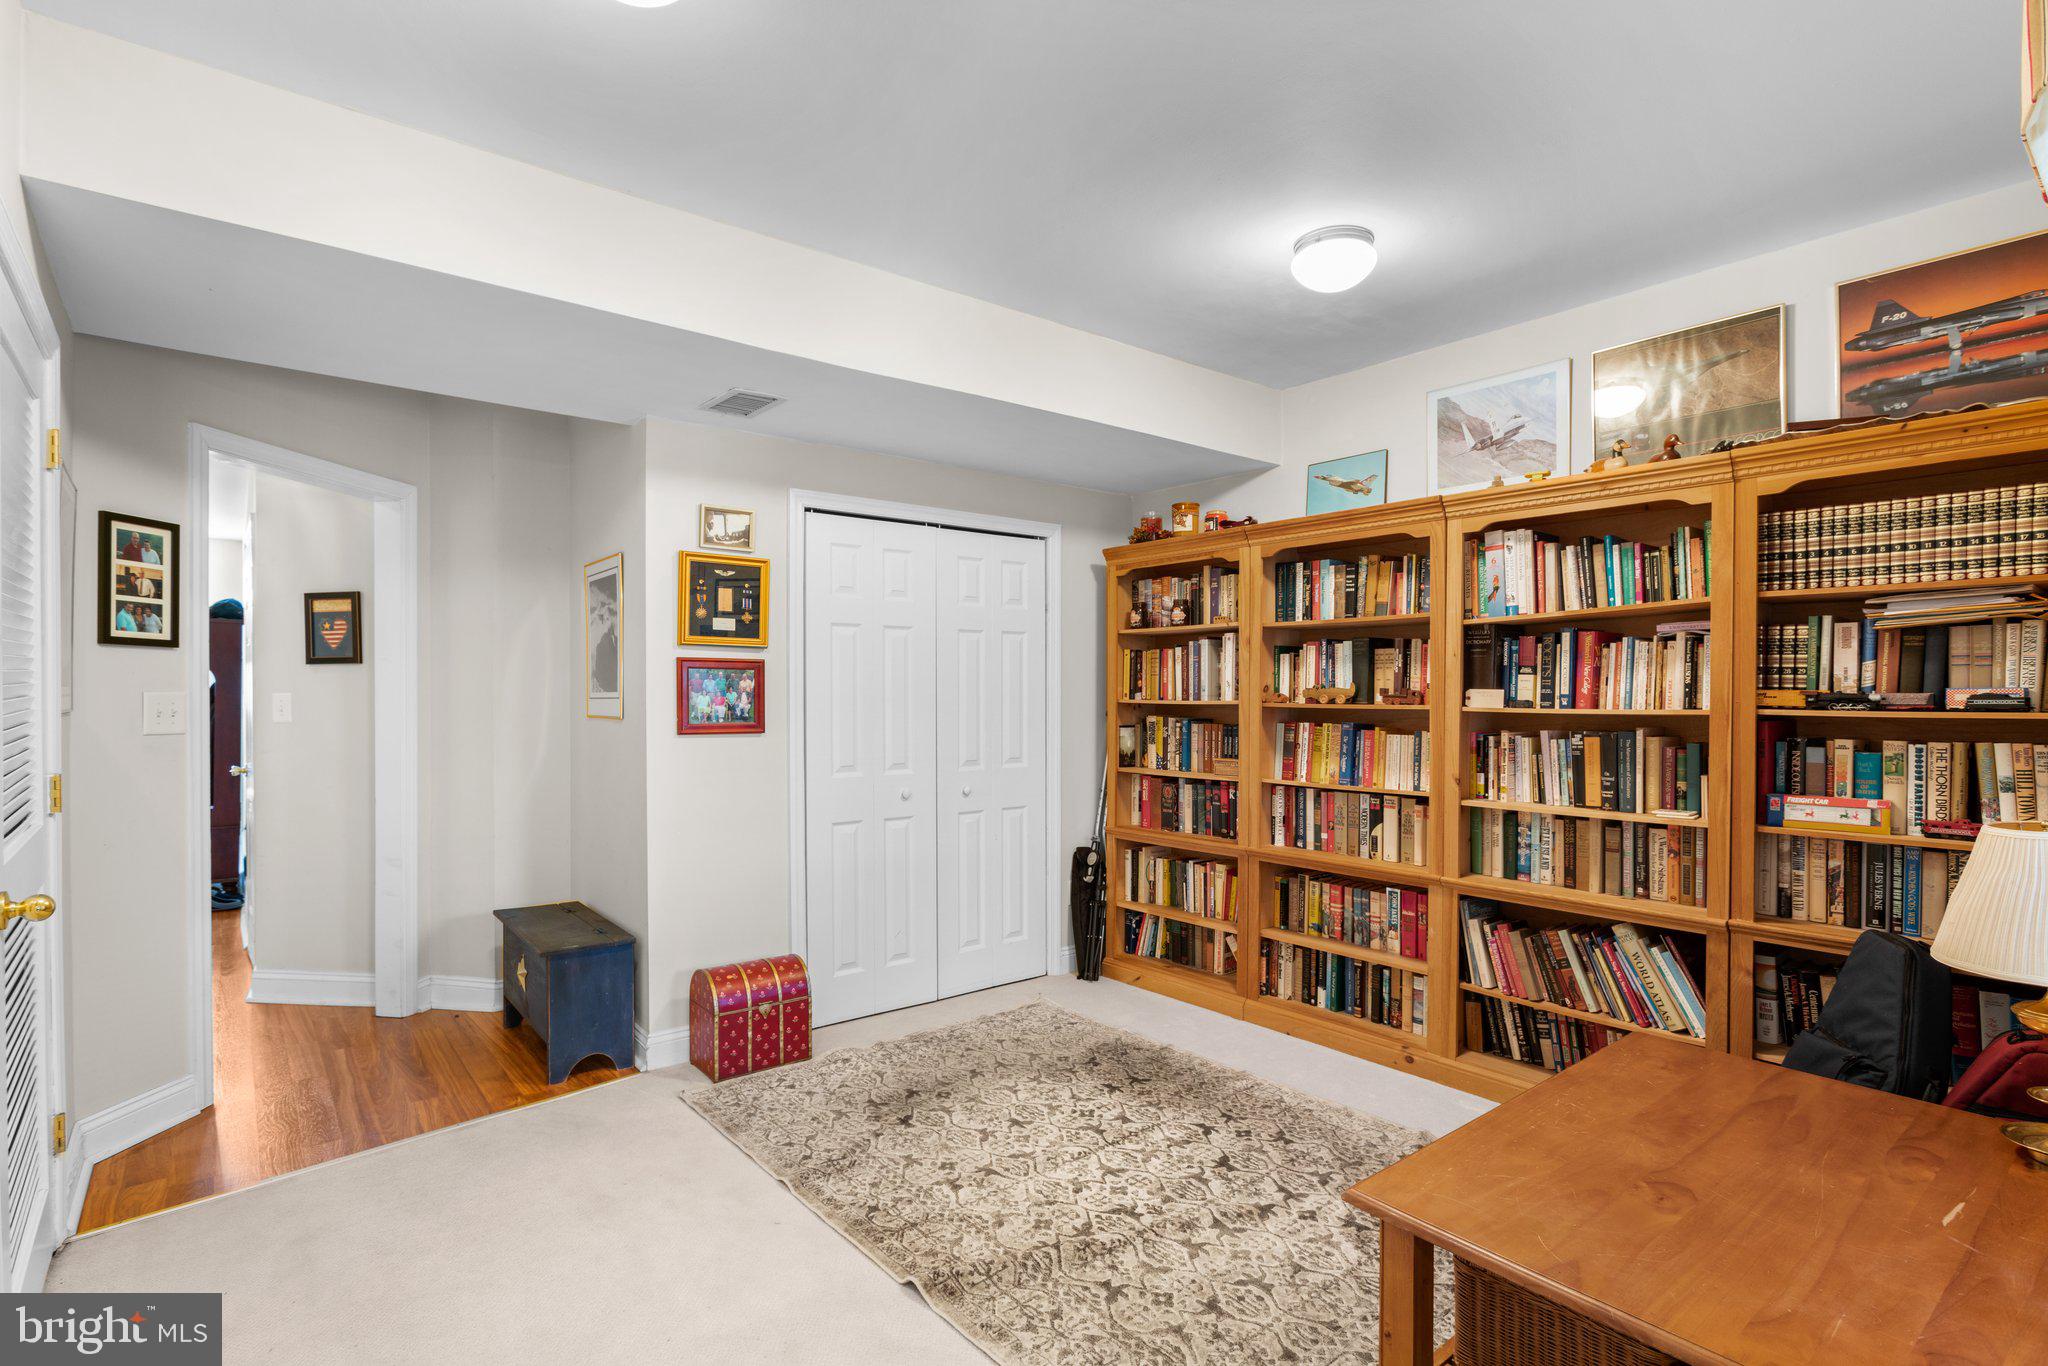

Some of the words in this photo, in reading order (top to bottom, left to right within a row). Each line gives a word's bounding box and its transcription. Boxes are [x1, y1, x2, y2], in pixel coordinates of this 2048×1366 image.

[1881, 311, 1908, 324] F-20
[1584, 664, 1592, 677] New
[1582, 677, 1590, 695] College
[1936, 748, 1947, 763] THE
[1792, 773, 1800, 795] OUTSI
[1936, 765, 1947, 797] THORN
[2016, 770, 2033, 792] HILL
[1936, 800, 1947, 821] BIRDS
[2017, 794, 2036, 822] TOWN
[1874, 862, 1883, 883] JULES
[1874, 885, 1883, 911] VERNE
[1908, 912, 1916, 925] WIFE
[1632, 951, 1655, 990] WORLD
[1651, 991, 1672, 1022] ATLAS
